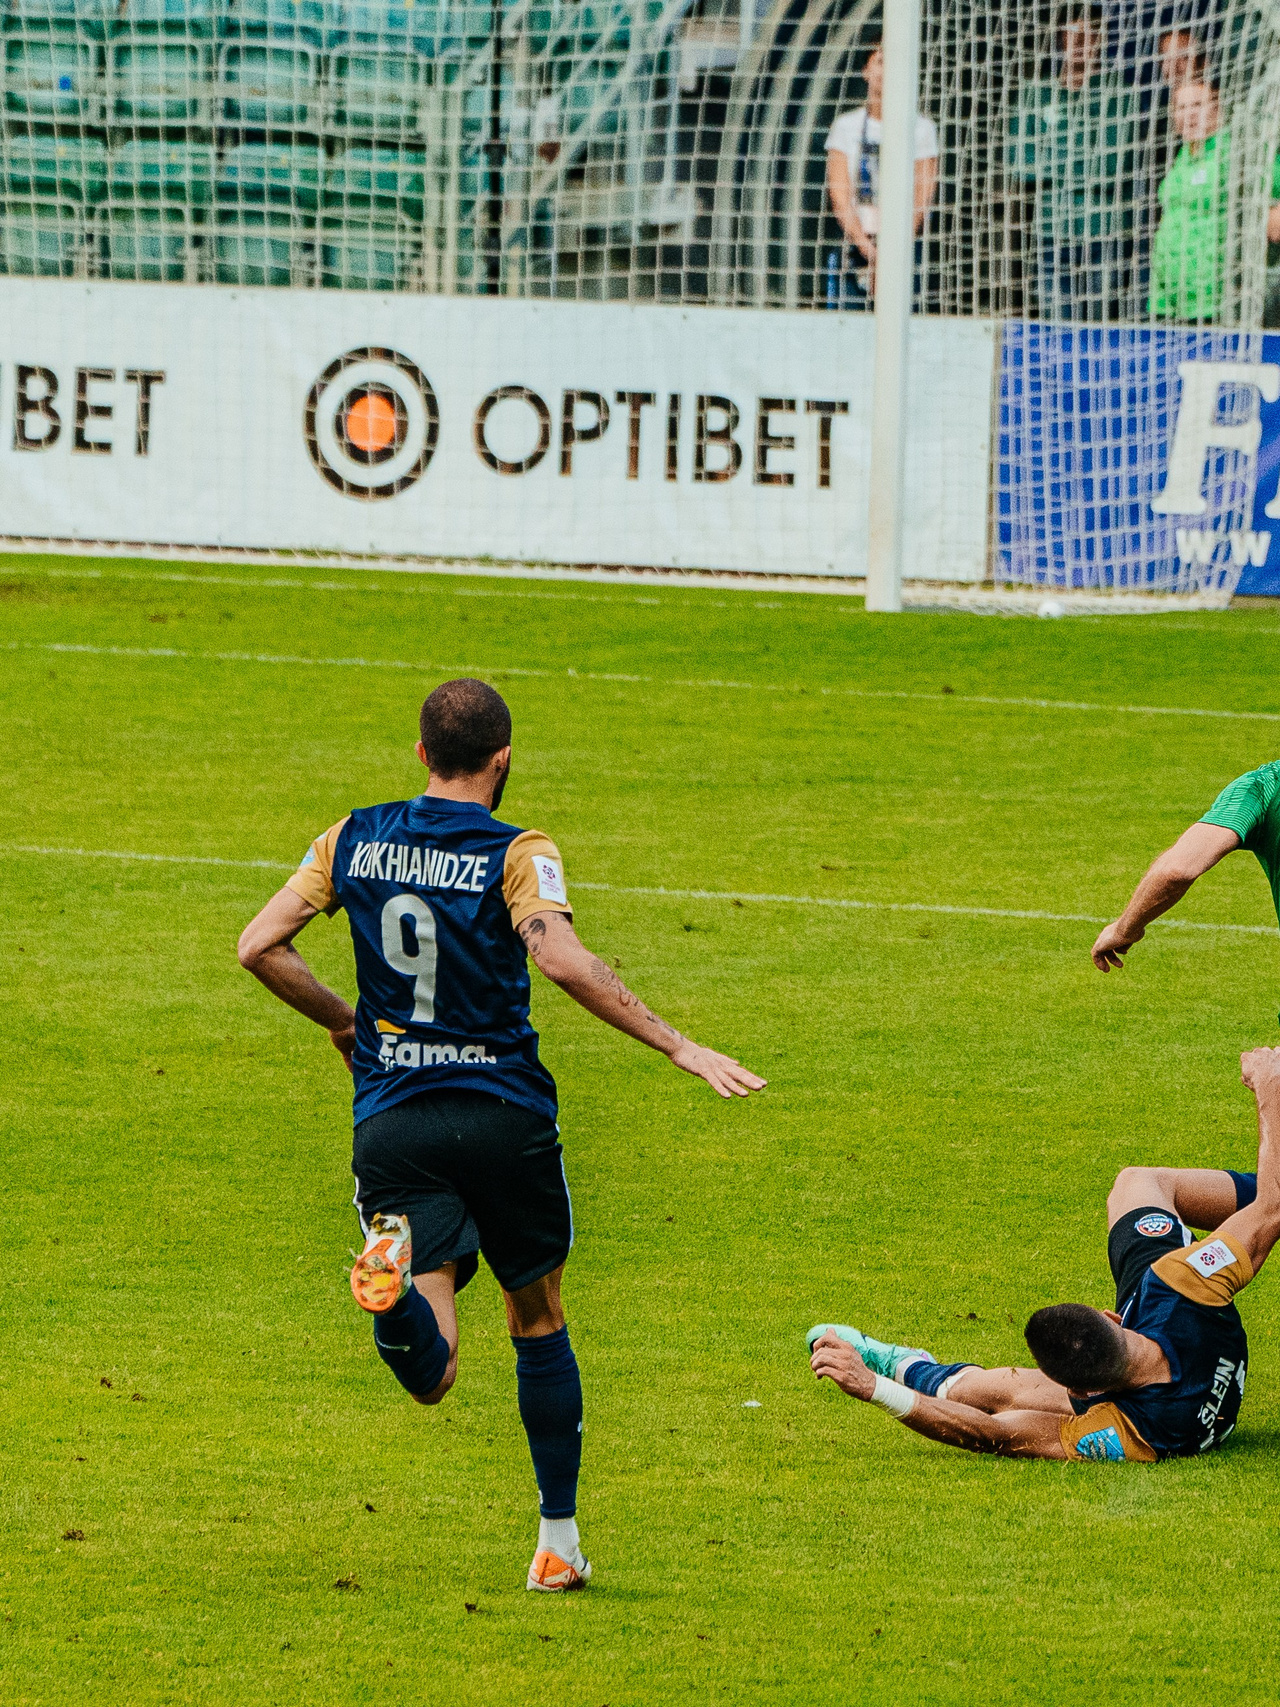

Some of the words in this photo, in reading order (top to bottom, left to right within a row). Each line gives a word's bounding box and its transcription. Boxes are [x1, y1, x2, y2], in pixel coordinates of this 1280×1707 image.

[0, 364, 165, 458] BET
[472, 385, 850, 489] OPTIBET
[346, 841, 489, 892] KOKHIANIDZE
[381, 893, 438, 1023] 9
